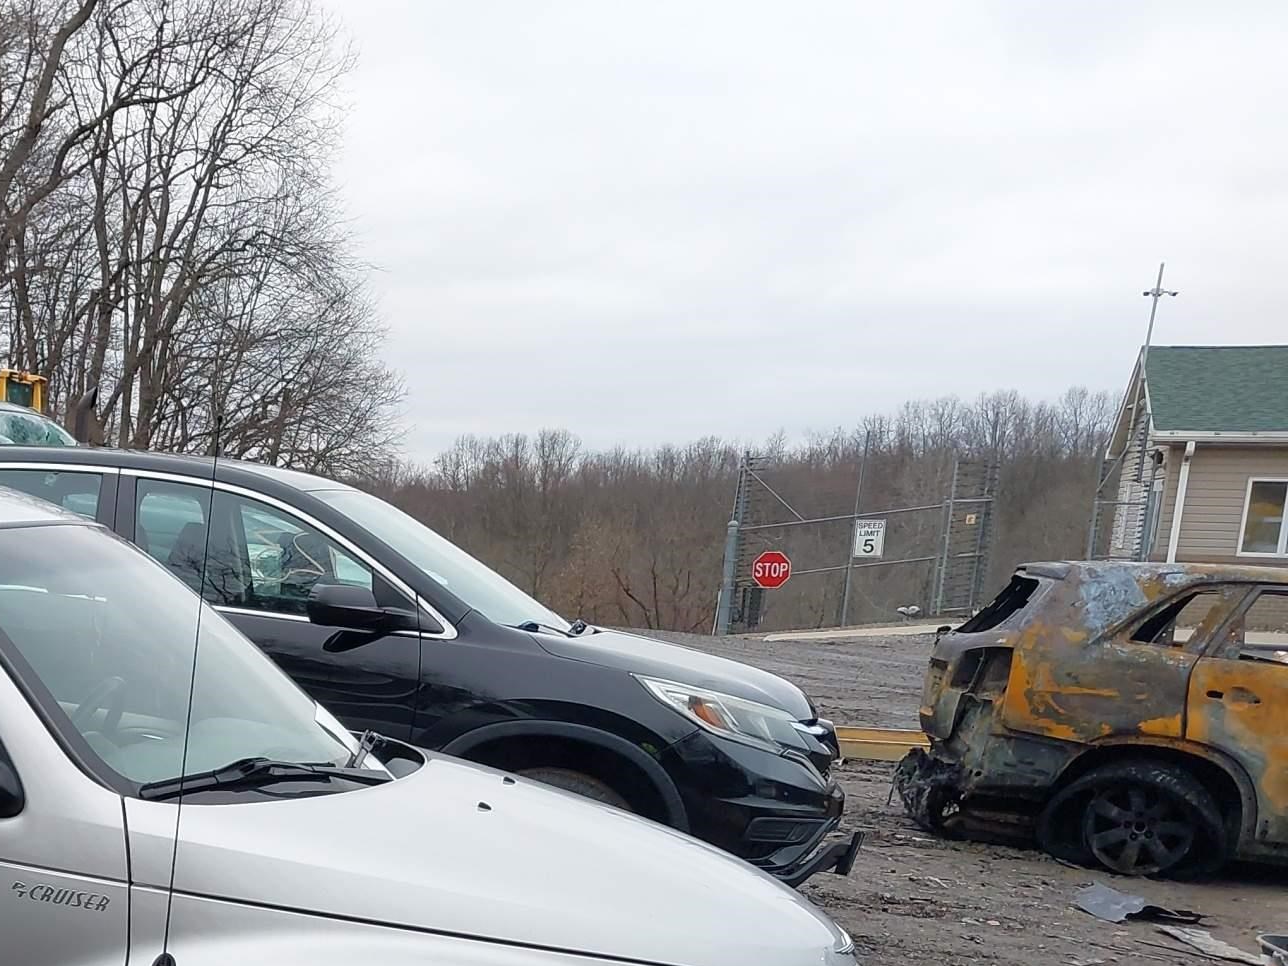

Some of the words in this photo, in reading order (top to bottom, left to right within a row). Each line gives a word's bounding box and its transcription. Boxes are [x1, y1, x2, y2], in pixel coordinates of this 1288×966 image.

[862, 539, 874, 553] 5
[755, 562, 788, 577] STOP
[29, 884, 111, 911] CRUISER
